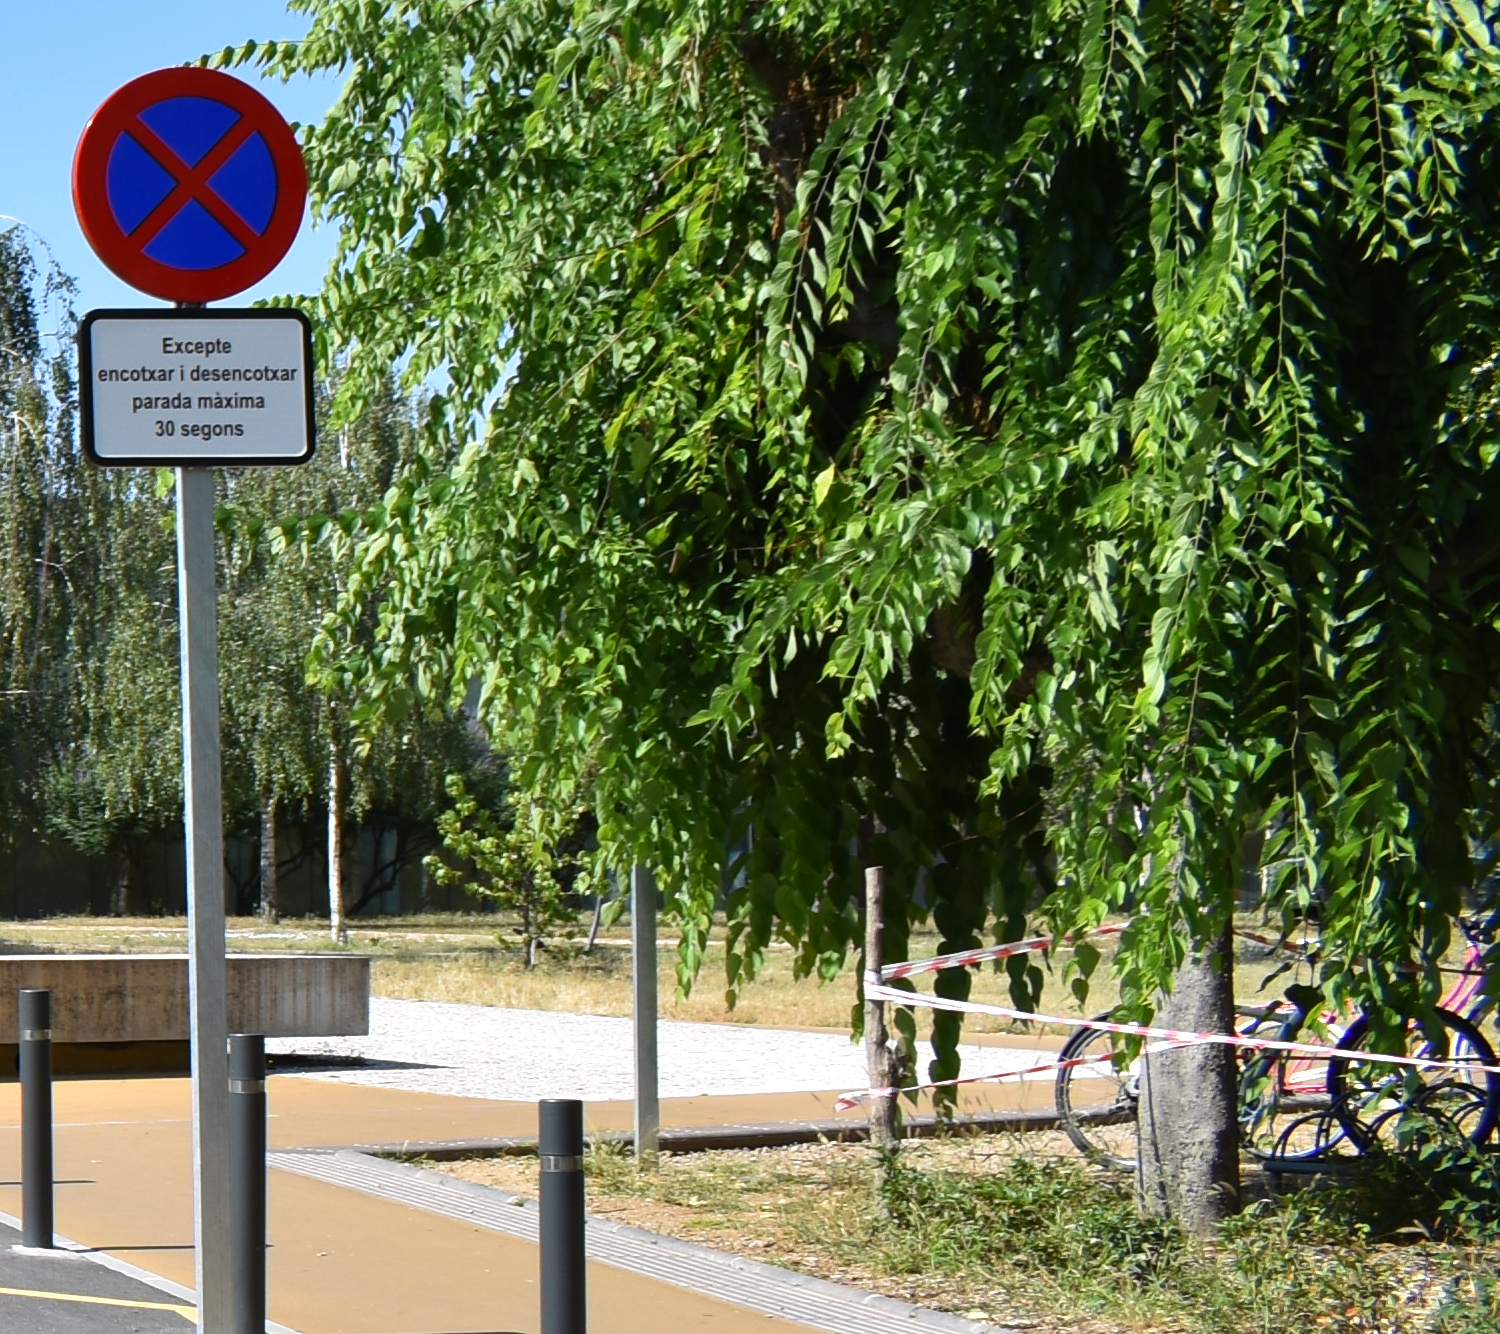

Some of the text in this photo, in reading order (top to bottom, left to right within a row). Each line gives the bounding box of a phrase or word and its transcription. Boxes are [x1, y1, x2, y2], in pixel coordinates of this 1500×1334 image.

[162, 337, 232, 358] Excepte
[98, 364, 298, 382] encotxar i desencotxar
[132, 391, 265, 414] parada màxima
[155, 420, 244, 441] 30 segons
